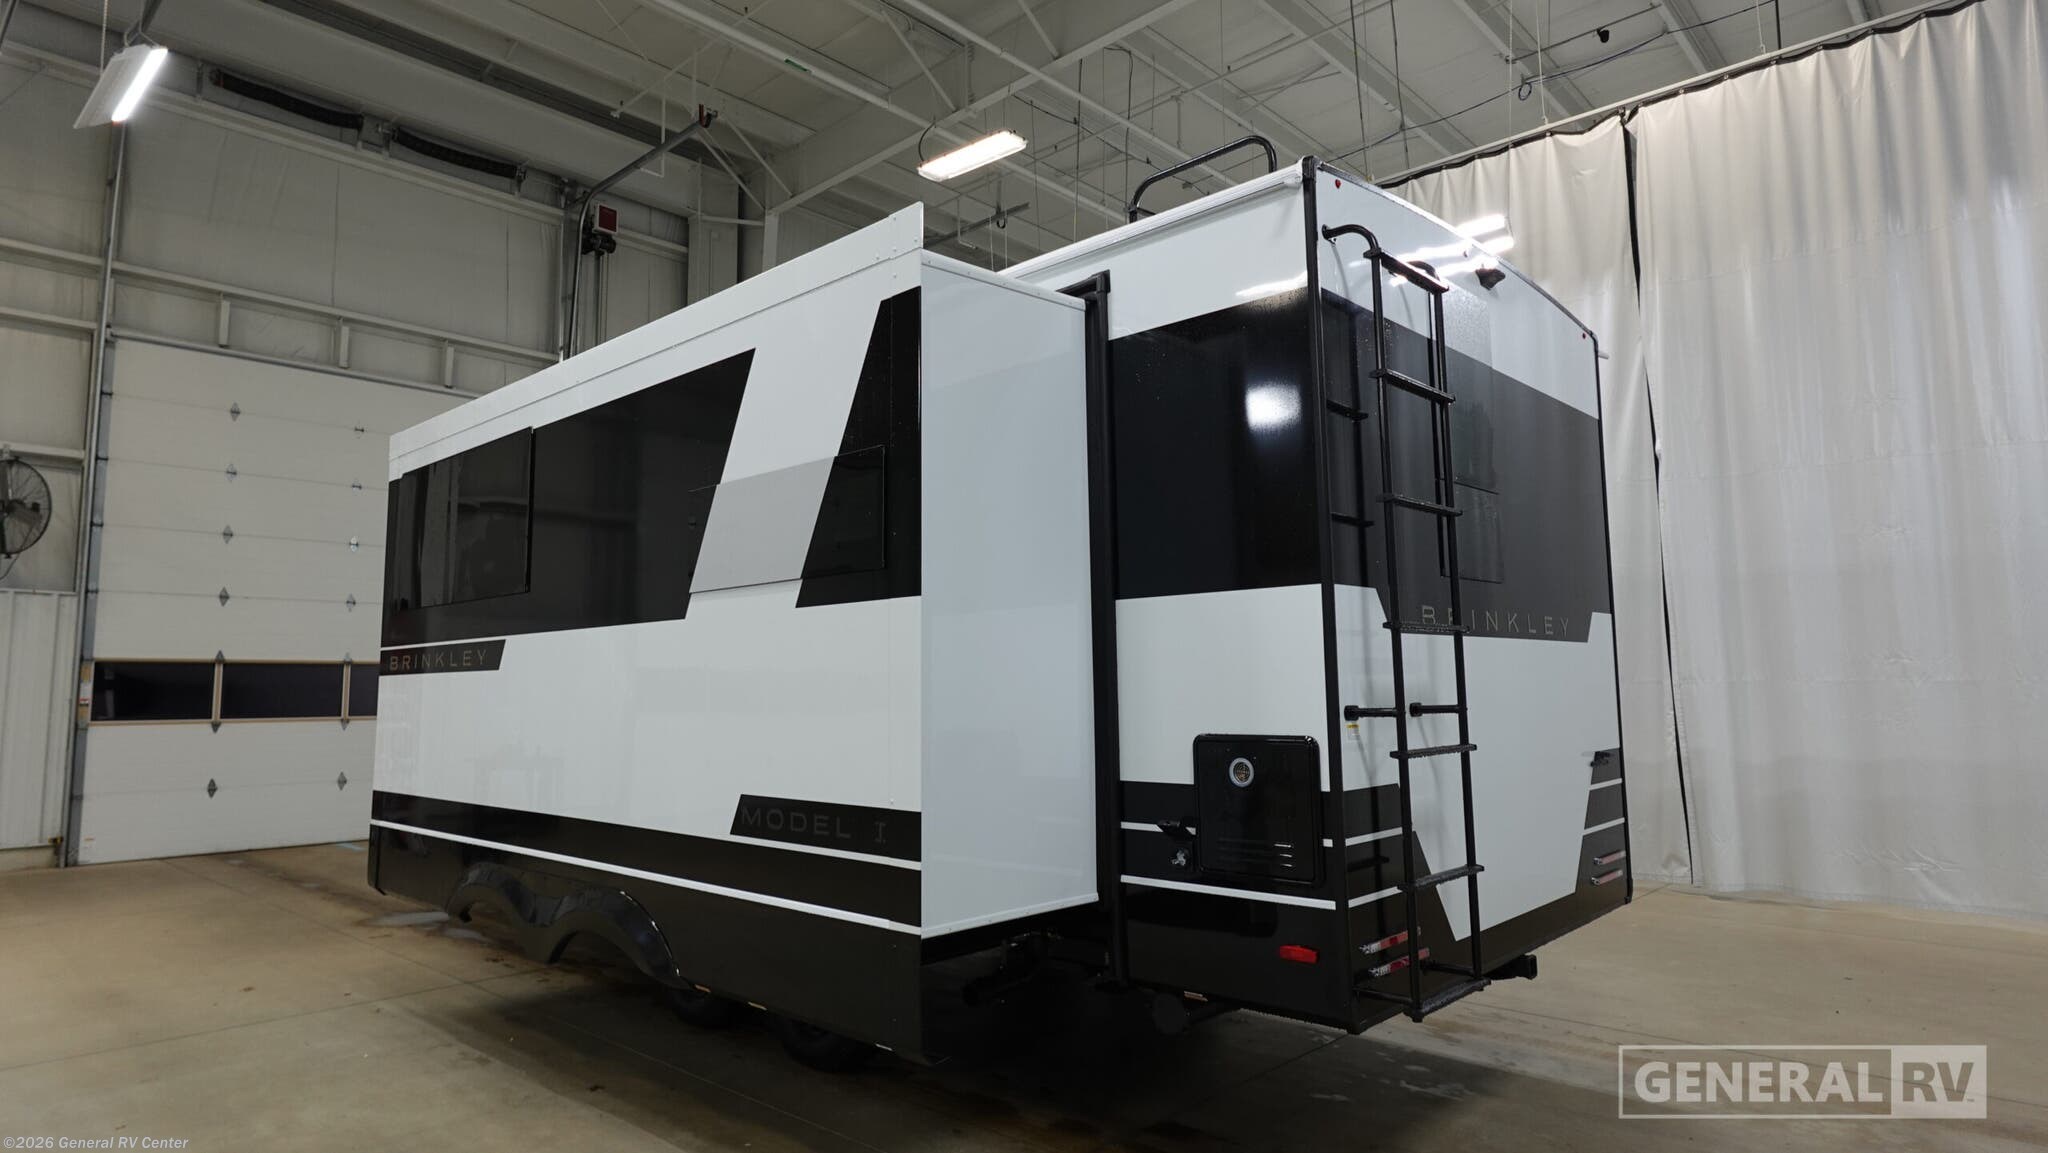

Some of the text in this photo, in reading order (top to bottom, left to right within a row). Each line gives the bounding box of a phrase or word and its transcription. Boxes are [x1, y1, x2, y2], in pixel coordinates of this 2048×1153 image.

[1421, 604, 1569, 637] BINKLEY
[389, 650, 487, 671] BRINKLEY
[741, 804, 851, 839] MODEL
